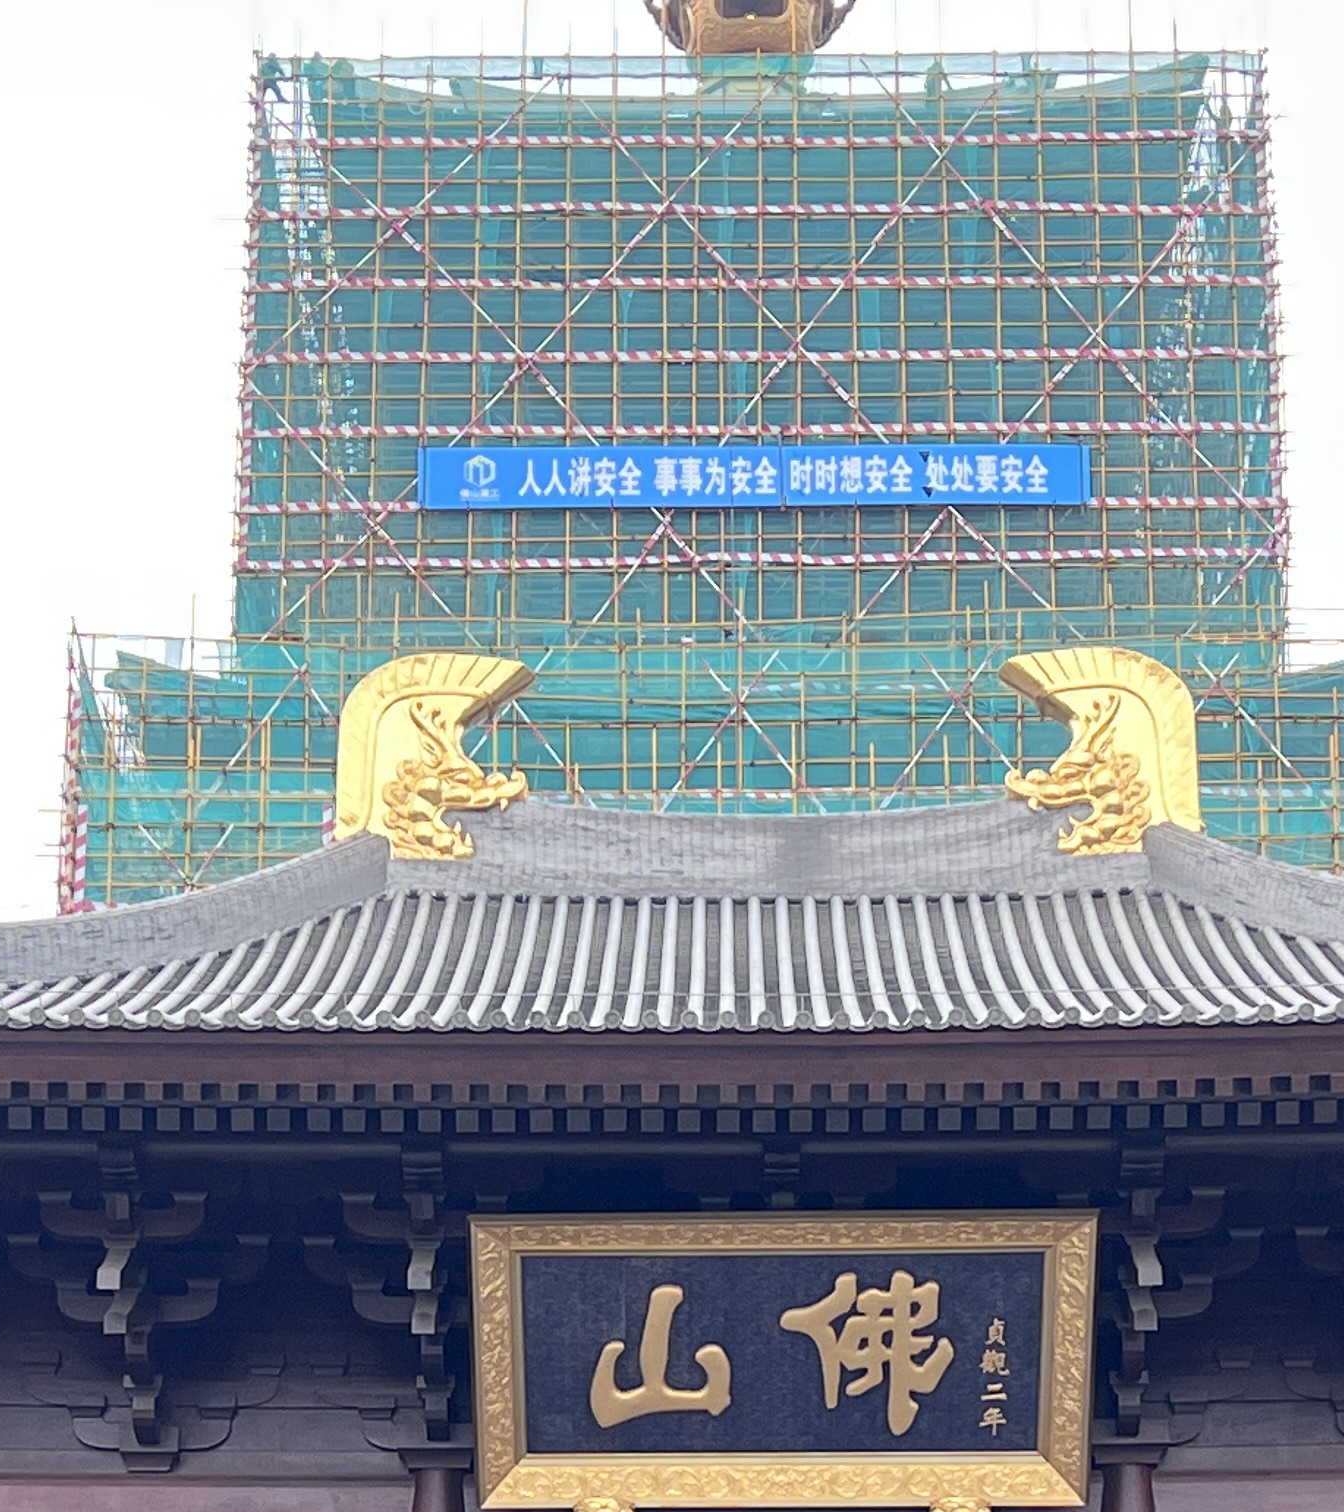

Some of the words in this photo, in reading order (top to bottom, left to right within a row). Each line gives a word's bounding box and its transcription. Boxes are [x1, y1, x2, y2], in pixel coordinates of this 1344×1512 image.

[518, 455, 642, 497] 人人讲安全
[654, 455, 778, 497] 事事为安全
[789, 453, 913, 495] 时时想安全
[924, 453, 1049, 494] 处处要安全
[978, 1317, 1010, 1437] 貞觀二年
